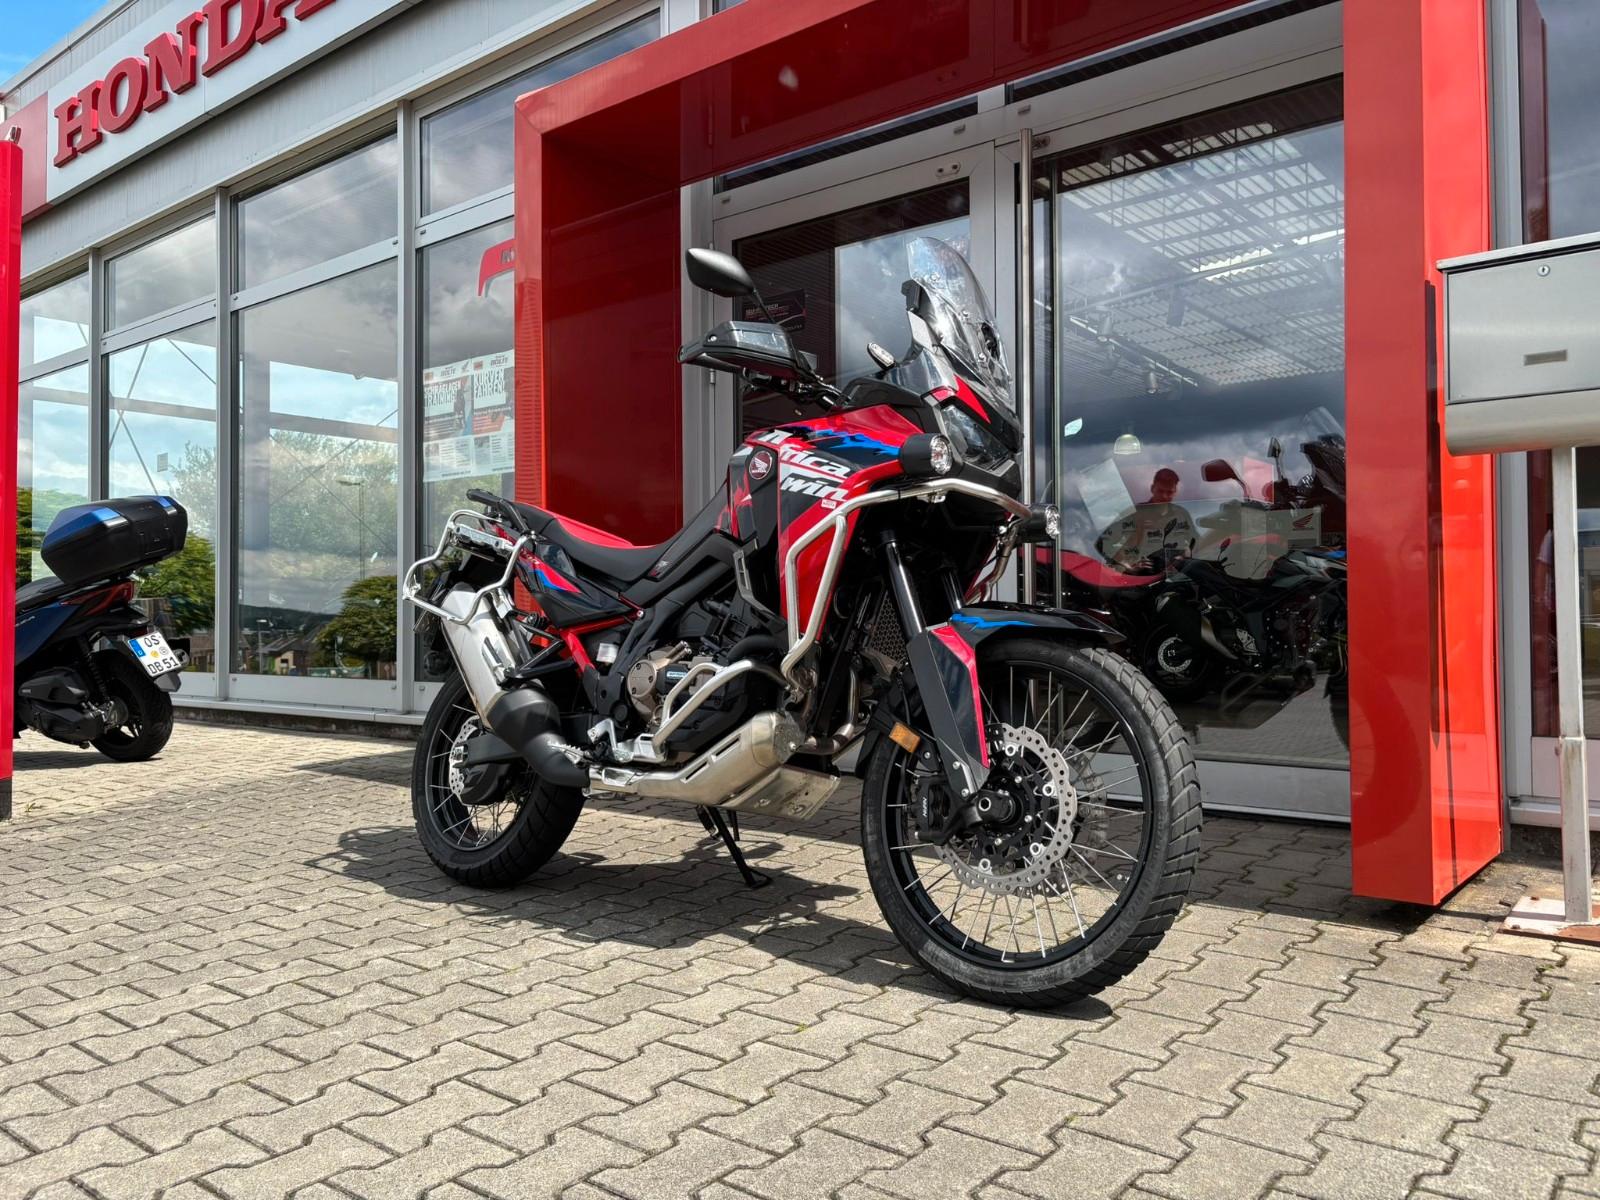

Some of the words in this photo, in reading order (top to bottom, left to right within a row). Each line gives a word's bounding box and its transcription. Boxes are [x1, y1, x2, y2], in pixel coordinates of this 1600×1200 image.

[144, 634, 160, 648] OS
[147, 661, 164, 675] DB
[162, 656, 179, 669] 51
